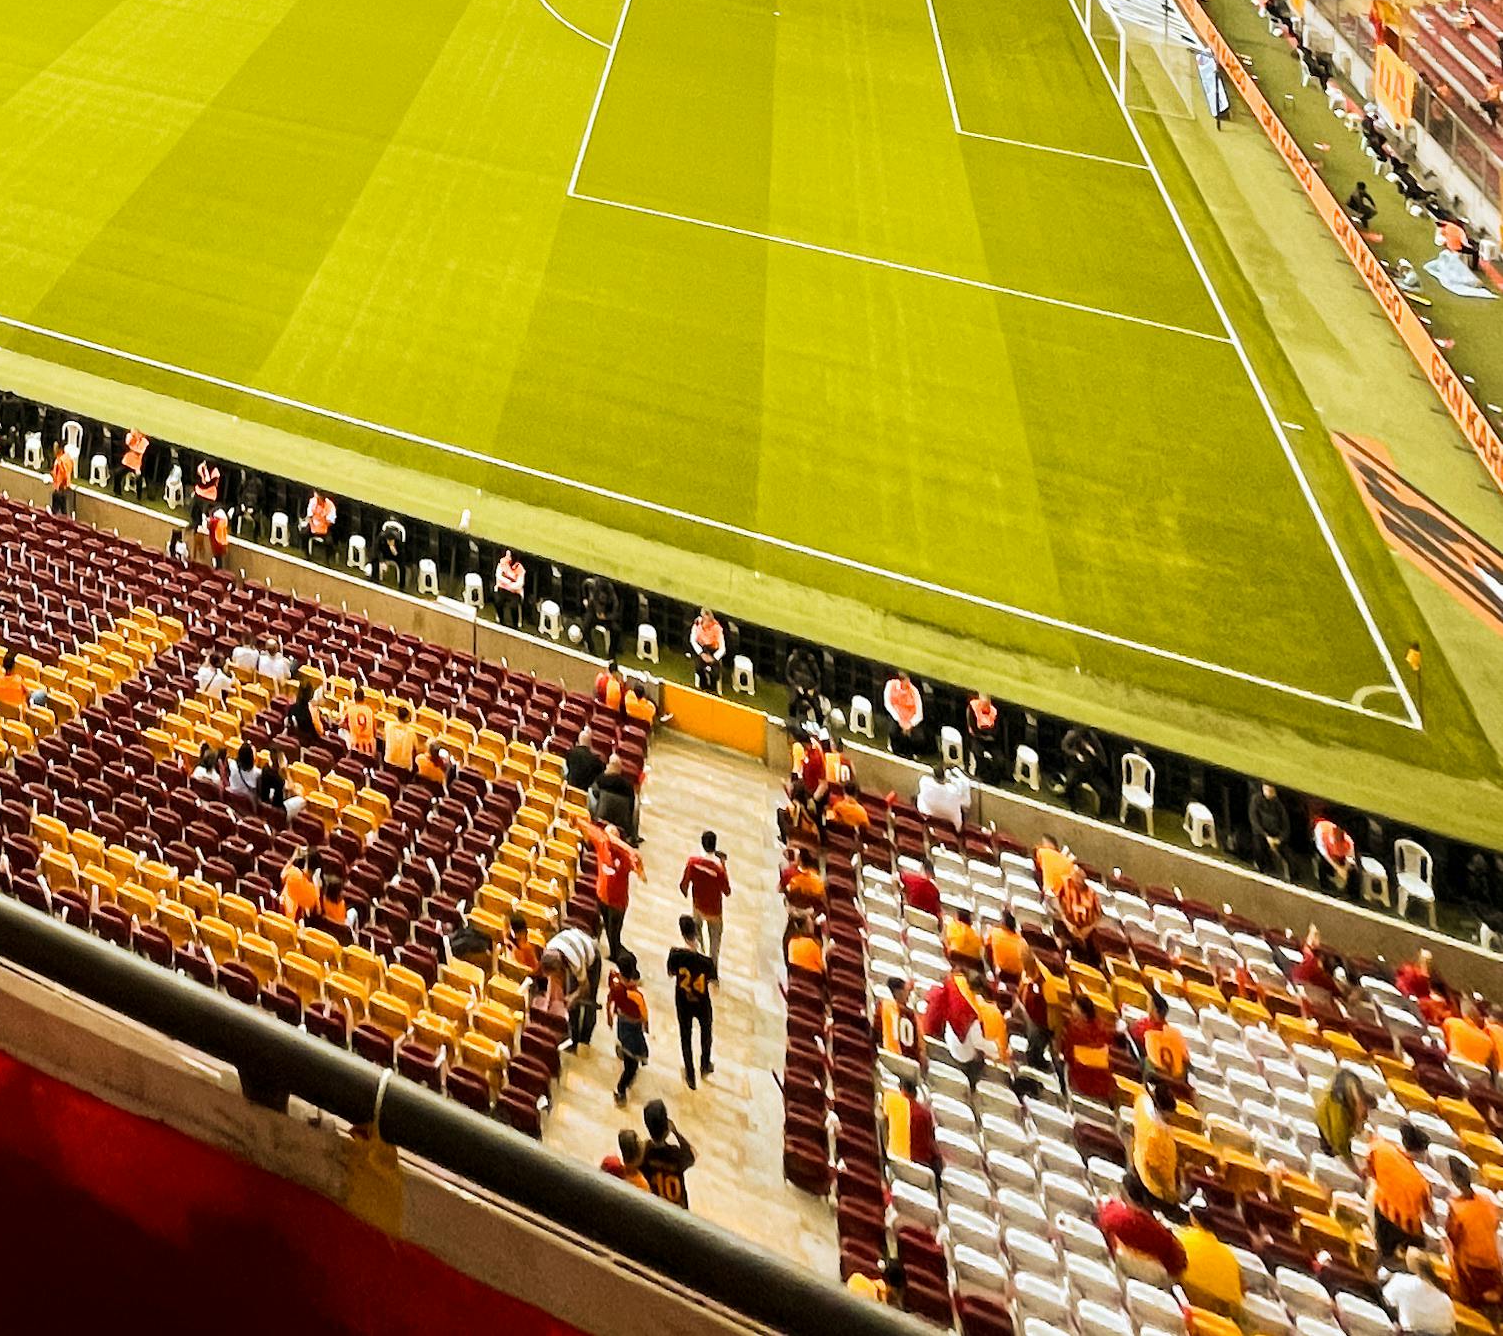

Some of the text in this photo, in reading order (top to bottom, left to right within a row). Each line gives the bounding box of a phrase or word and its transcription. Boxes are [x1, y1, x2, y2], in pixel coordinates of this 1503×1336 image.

[1431, 352, 1464, 421] GKN
[357, 712, 367, 733] 9
[678, 967, 705, 996] 24
[892, 1013, 914, 1047] 10
